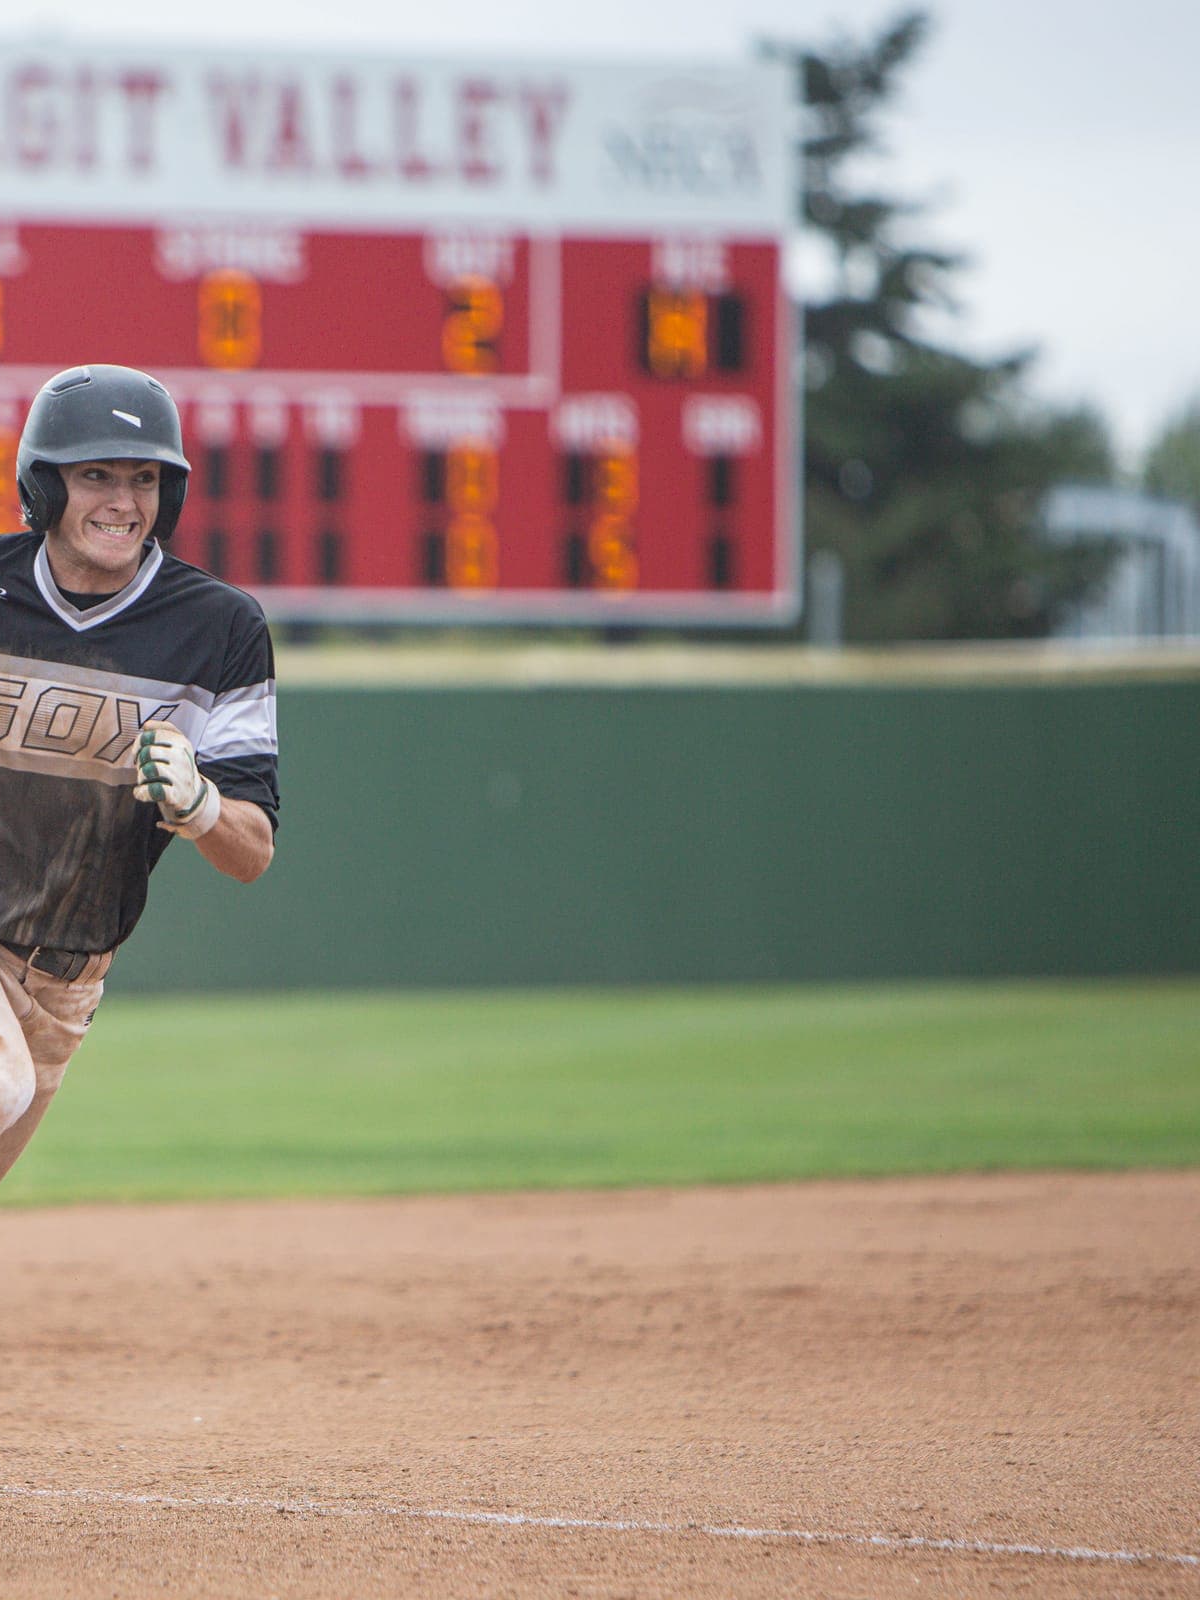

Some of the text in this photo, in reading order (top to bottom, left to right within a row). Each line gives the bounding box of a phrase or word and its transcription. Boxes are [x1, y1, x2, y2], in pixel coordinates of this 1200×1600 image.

[203, 70, 573, 186] VALLEY
[204, 272, 257, 367] 0
[446, 279, 500, 373] 2
